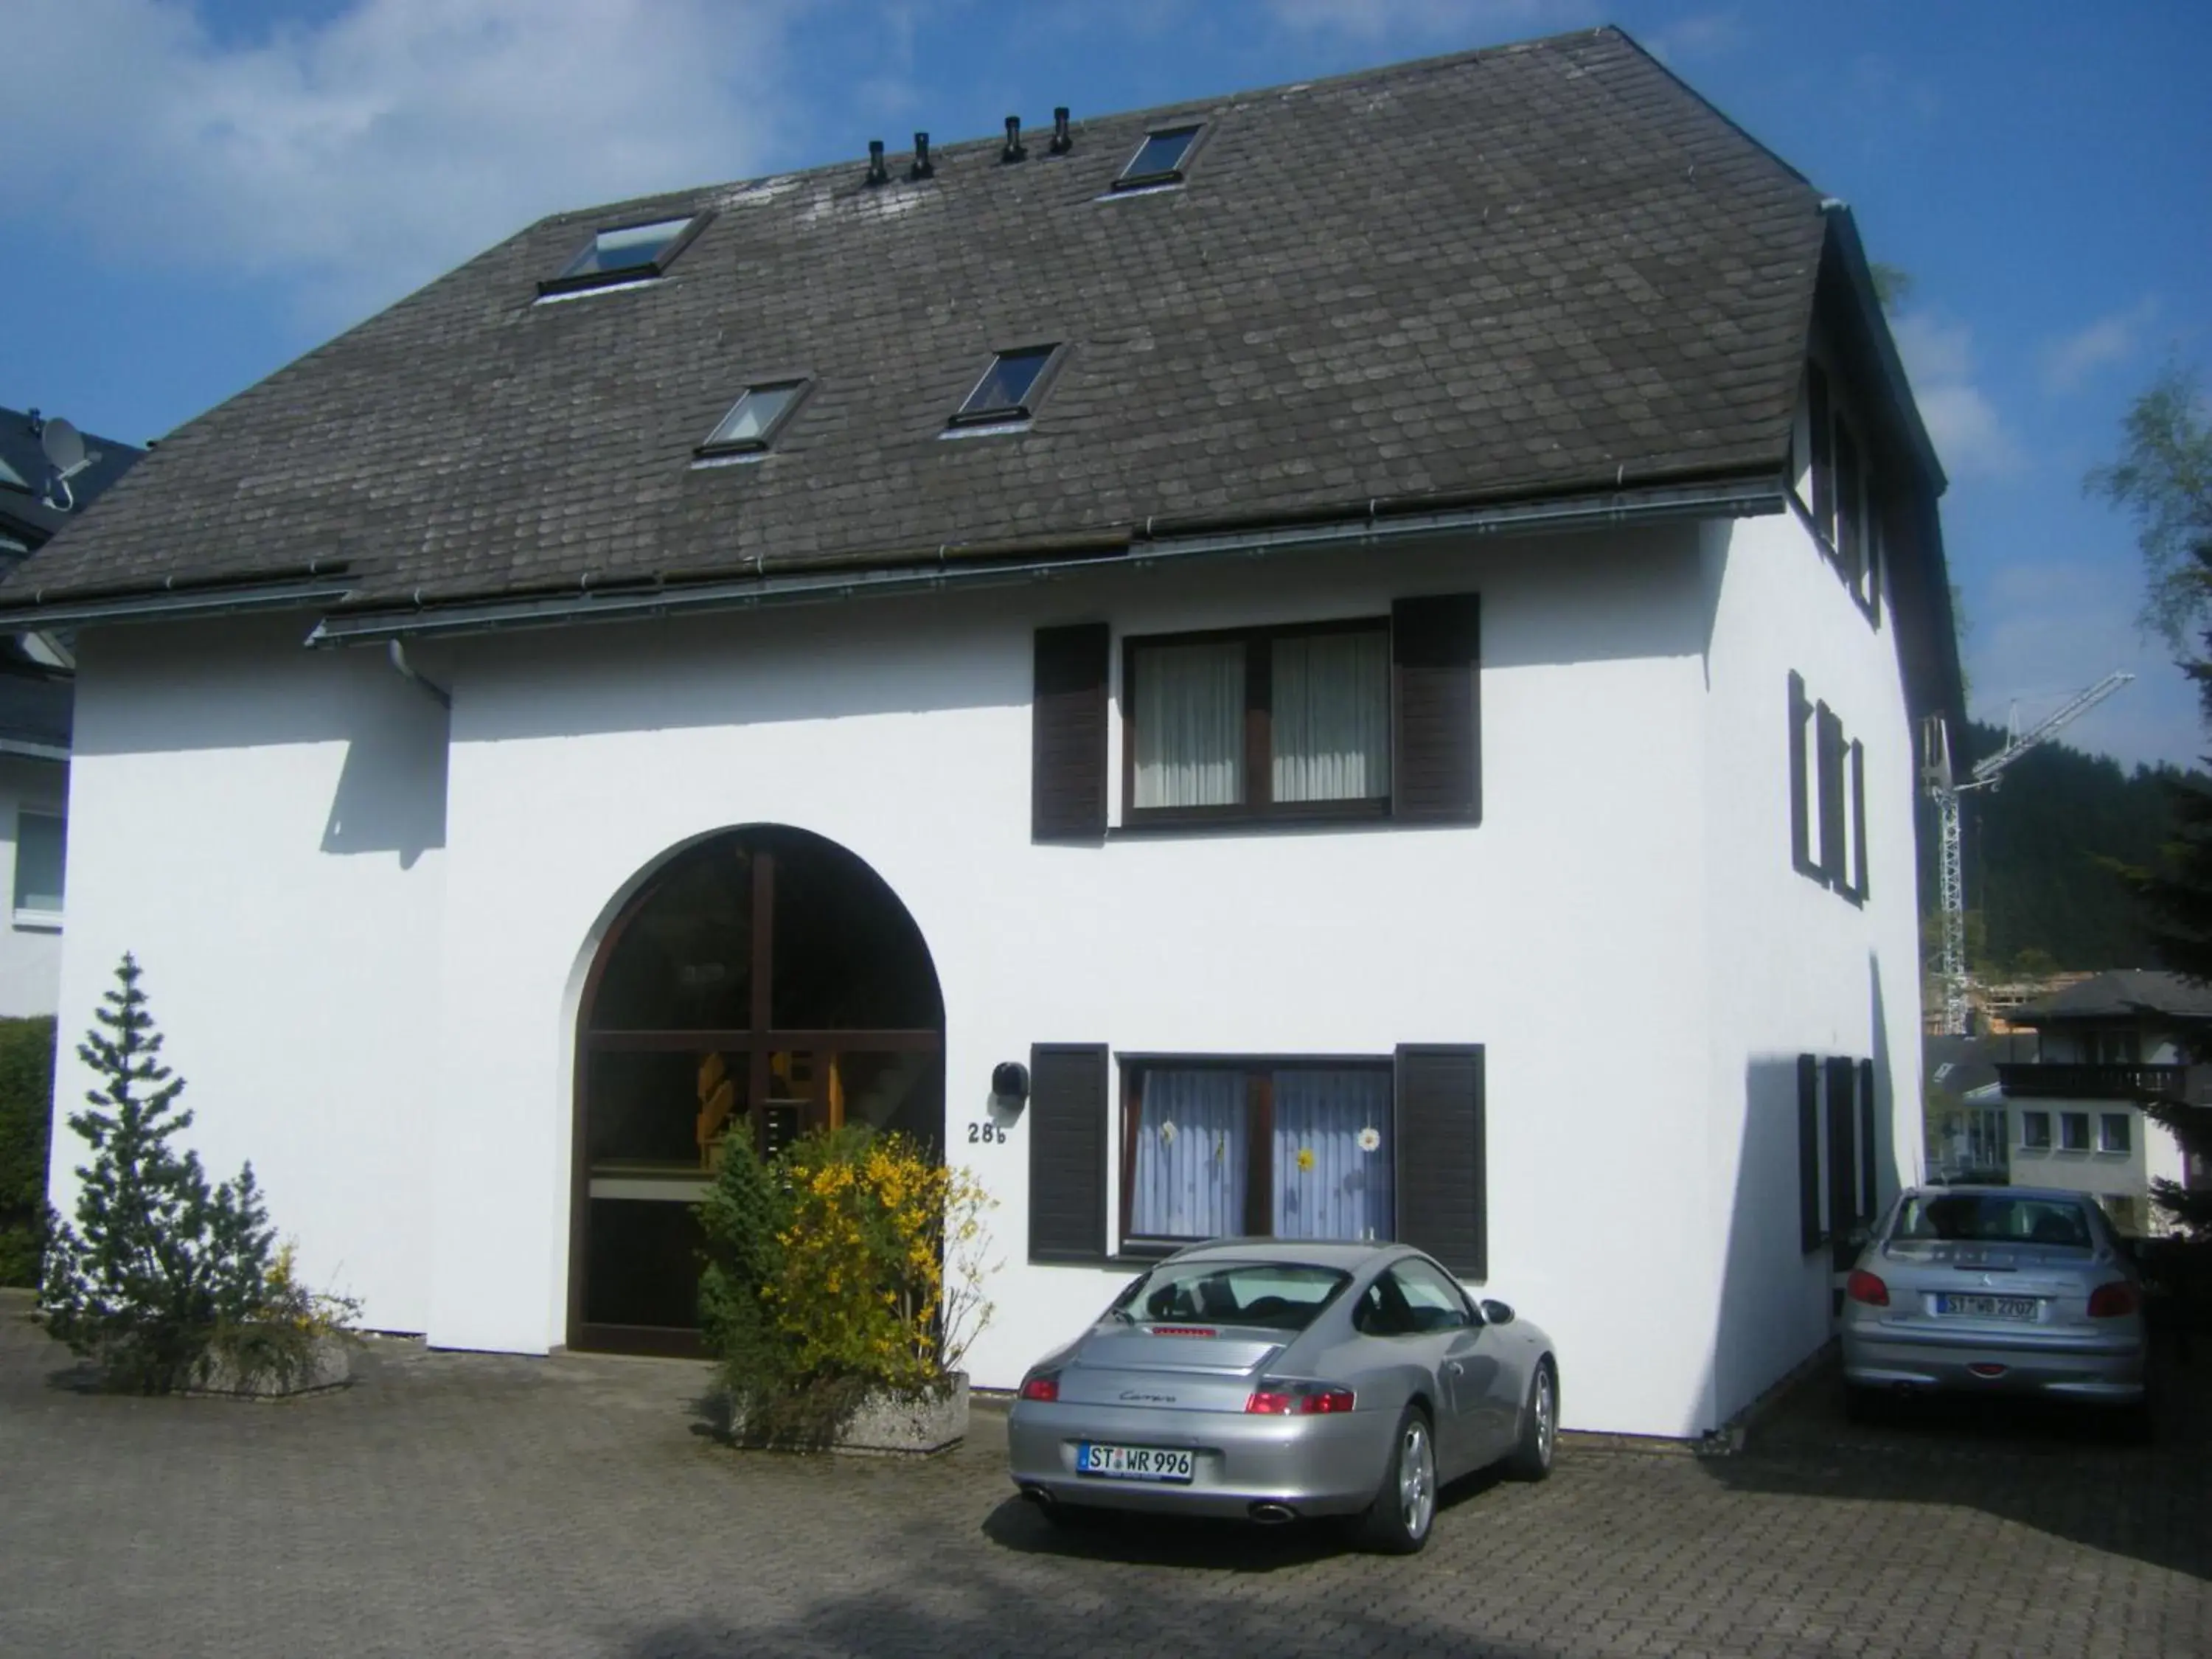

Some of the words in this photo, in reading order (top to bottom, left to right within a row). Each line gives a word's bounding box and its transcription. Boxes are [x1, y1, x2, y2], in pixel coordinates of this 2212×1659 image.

[1091, 1447, 1114, 1468] ST
[1127, 1450, 1150, 1472] WR
[1154, 1452, 1189, 1474] 996
